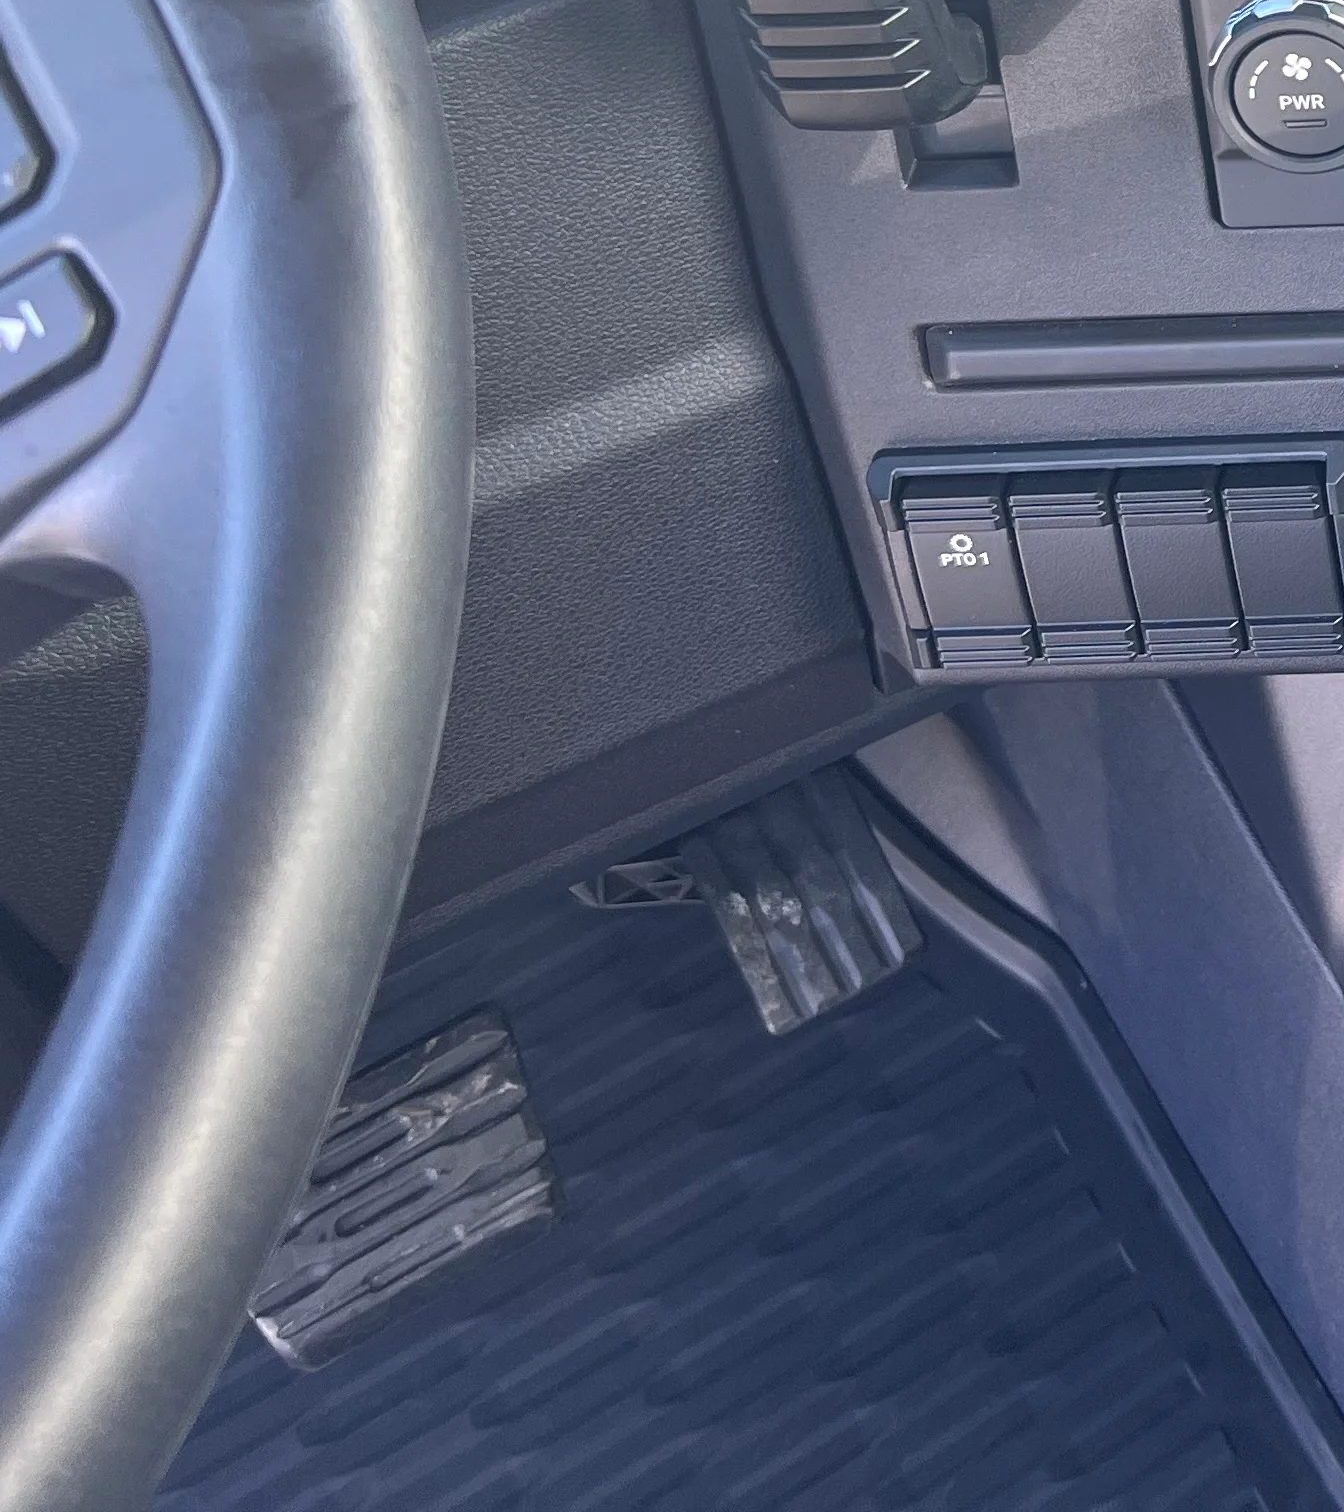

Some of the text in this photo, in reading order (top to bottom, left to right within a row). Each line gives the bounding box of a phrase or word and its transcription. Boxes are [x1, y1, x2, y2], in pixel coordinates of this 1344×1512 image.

[1278, 94, 1326, 111] PWR
[940, 551, 990, 567] PTO 1
